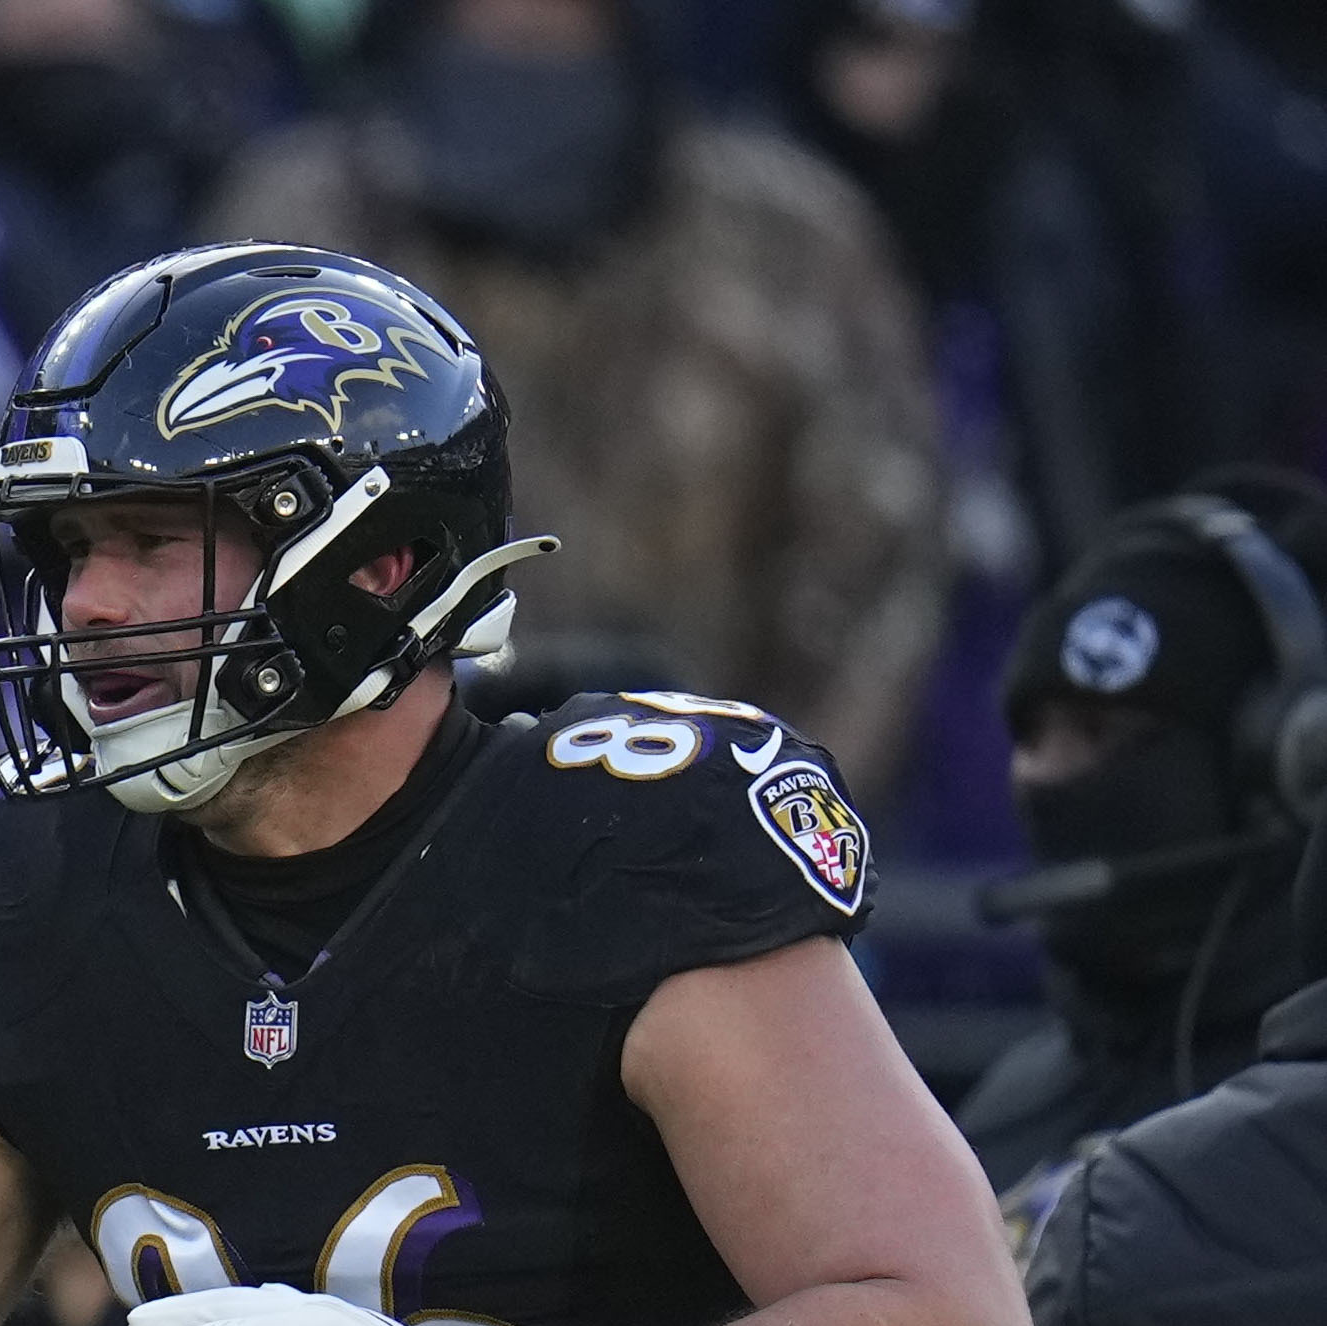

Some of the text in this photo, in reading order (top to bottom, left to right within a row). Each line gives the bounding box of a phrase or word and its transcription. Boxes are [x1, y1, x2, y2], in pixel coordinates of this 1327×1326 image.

[254, 299, 383, 355] B
[762, 772, 830, 803] RAVENS
[774, 795, 821, 837] B
[252, 1027, 288, 1056] NFL
[202, 1123, 338, 1151] RAVENS
